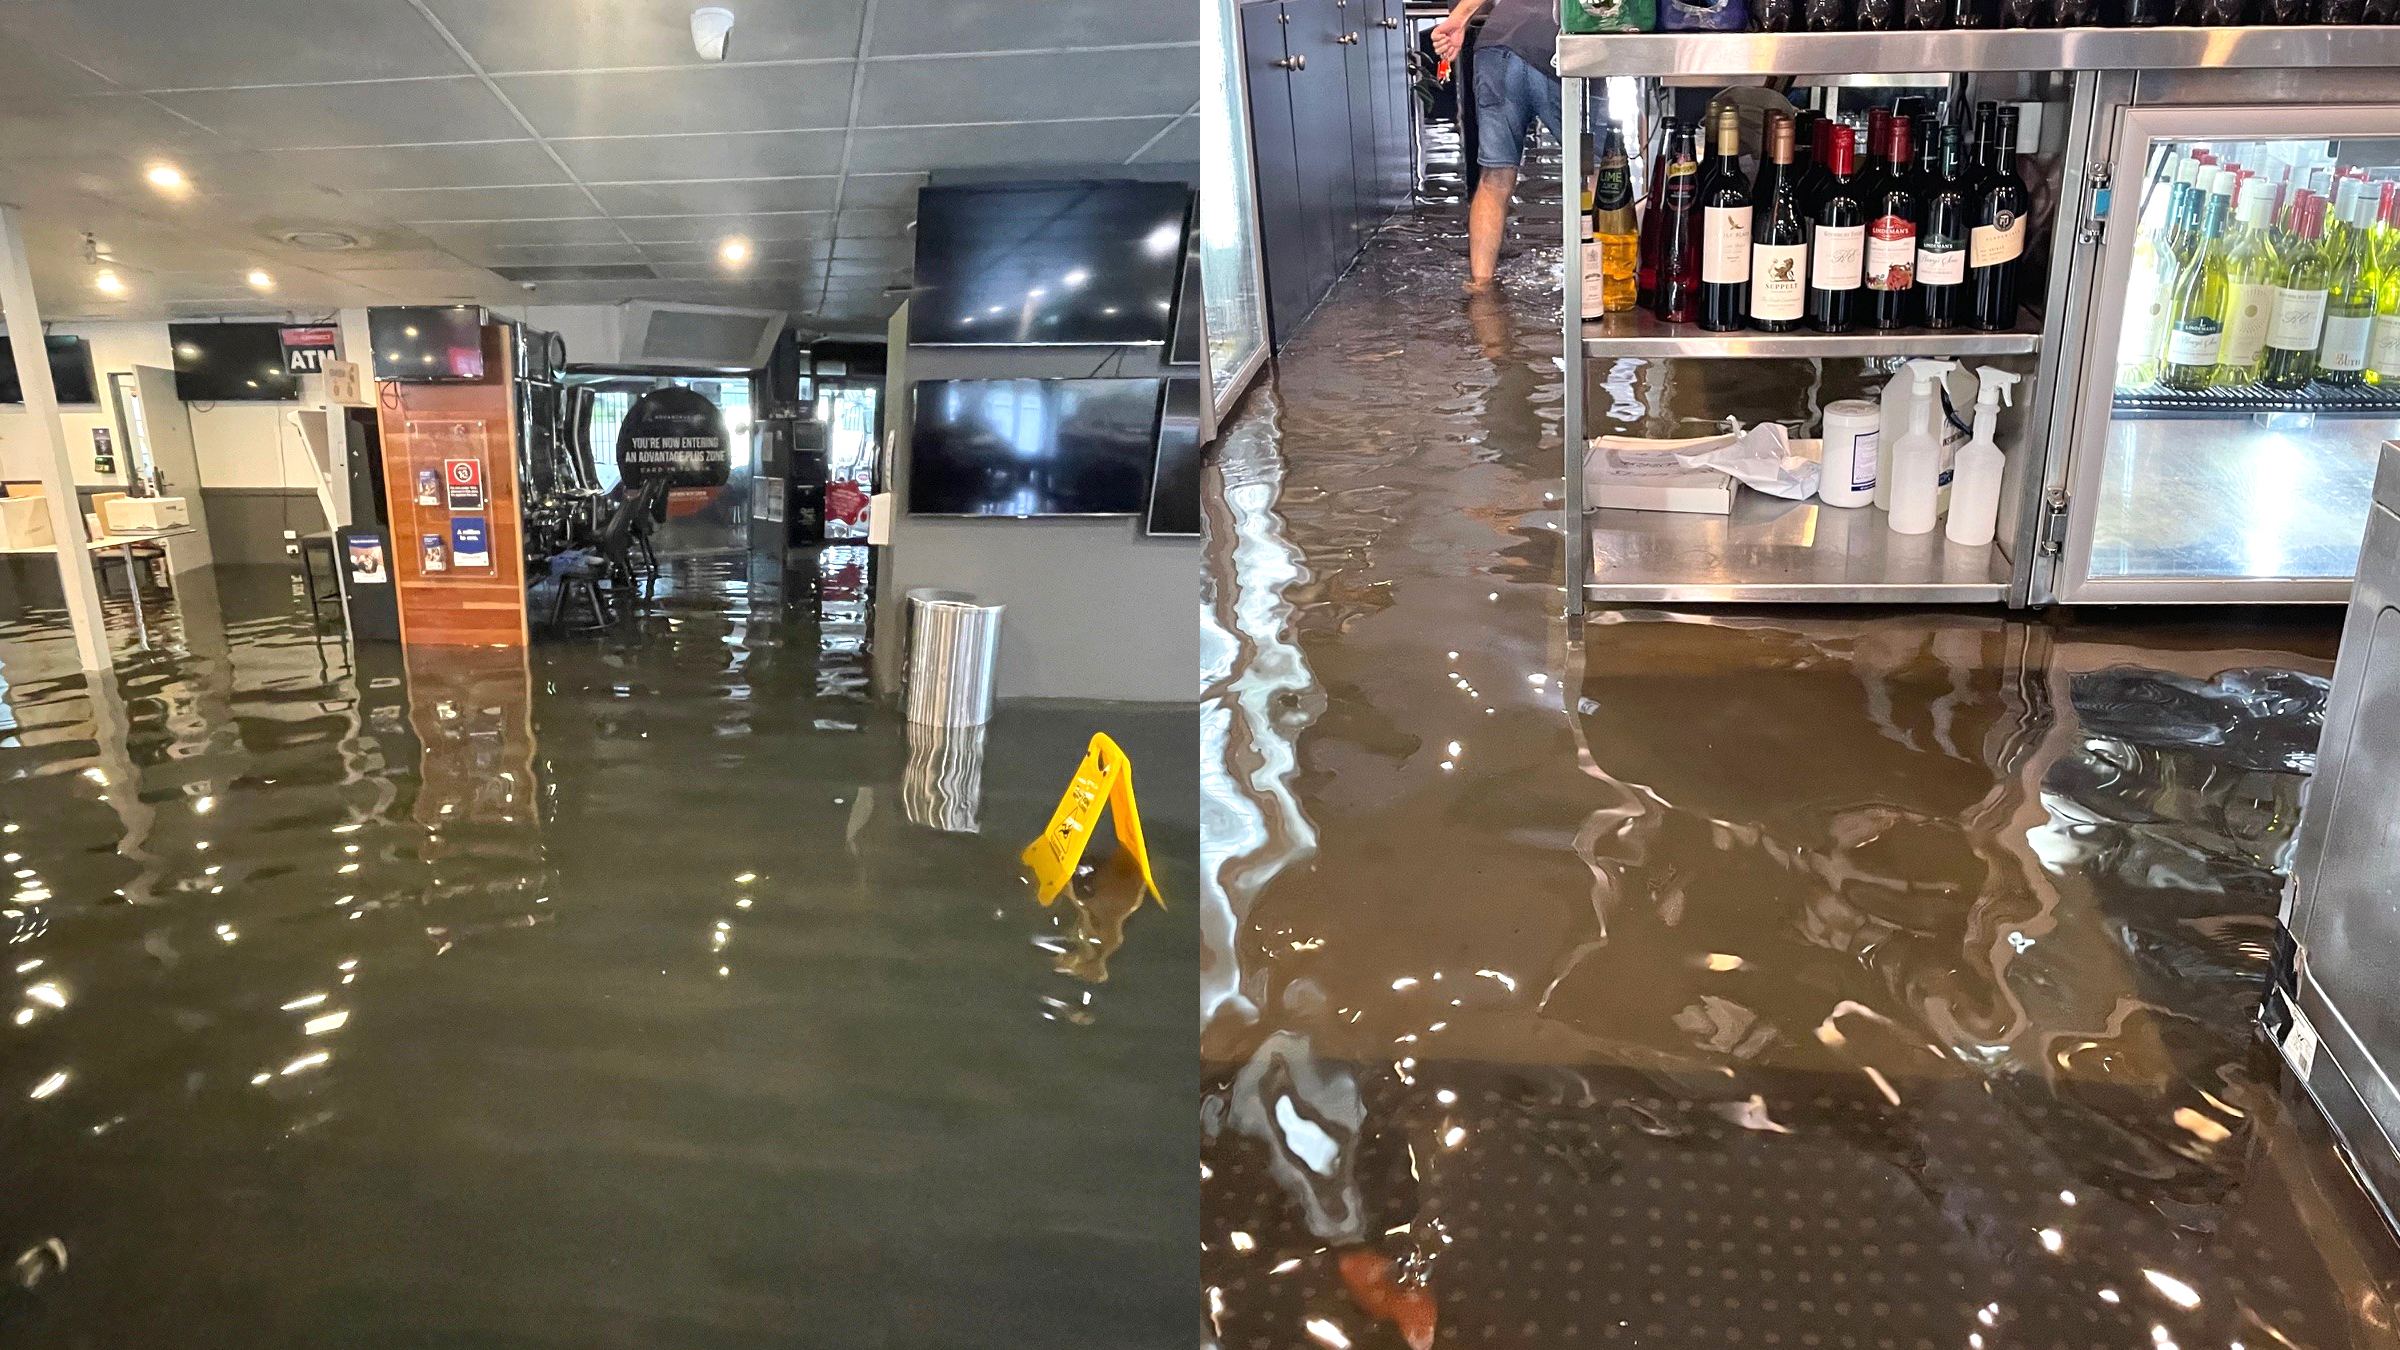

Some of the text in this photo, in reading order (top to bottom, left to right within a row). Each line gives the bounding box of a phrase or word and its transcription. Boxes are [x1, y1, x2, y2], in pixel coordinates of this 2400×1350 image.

[1600, 172, 1622, 183] LIME
[1765, 282, 1799, 290] SEPPELT
[290, 349, 336, 370] ATM
[631, 436, 719, 449] YOU'RE NOW ENTERING
[625, 450, 726, 463] AN ADVANTAGE PLUS ZONE
